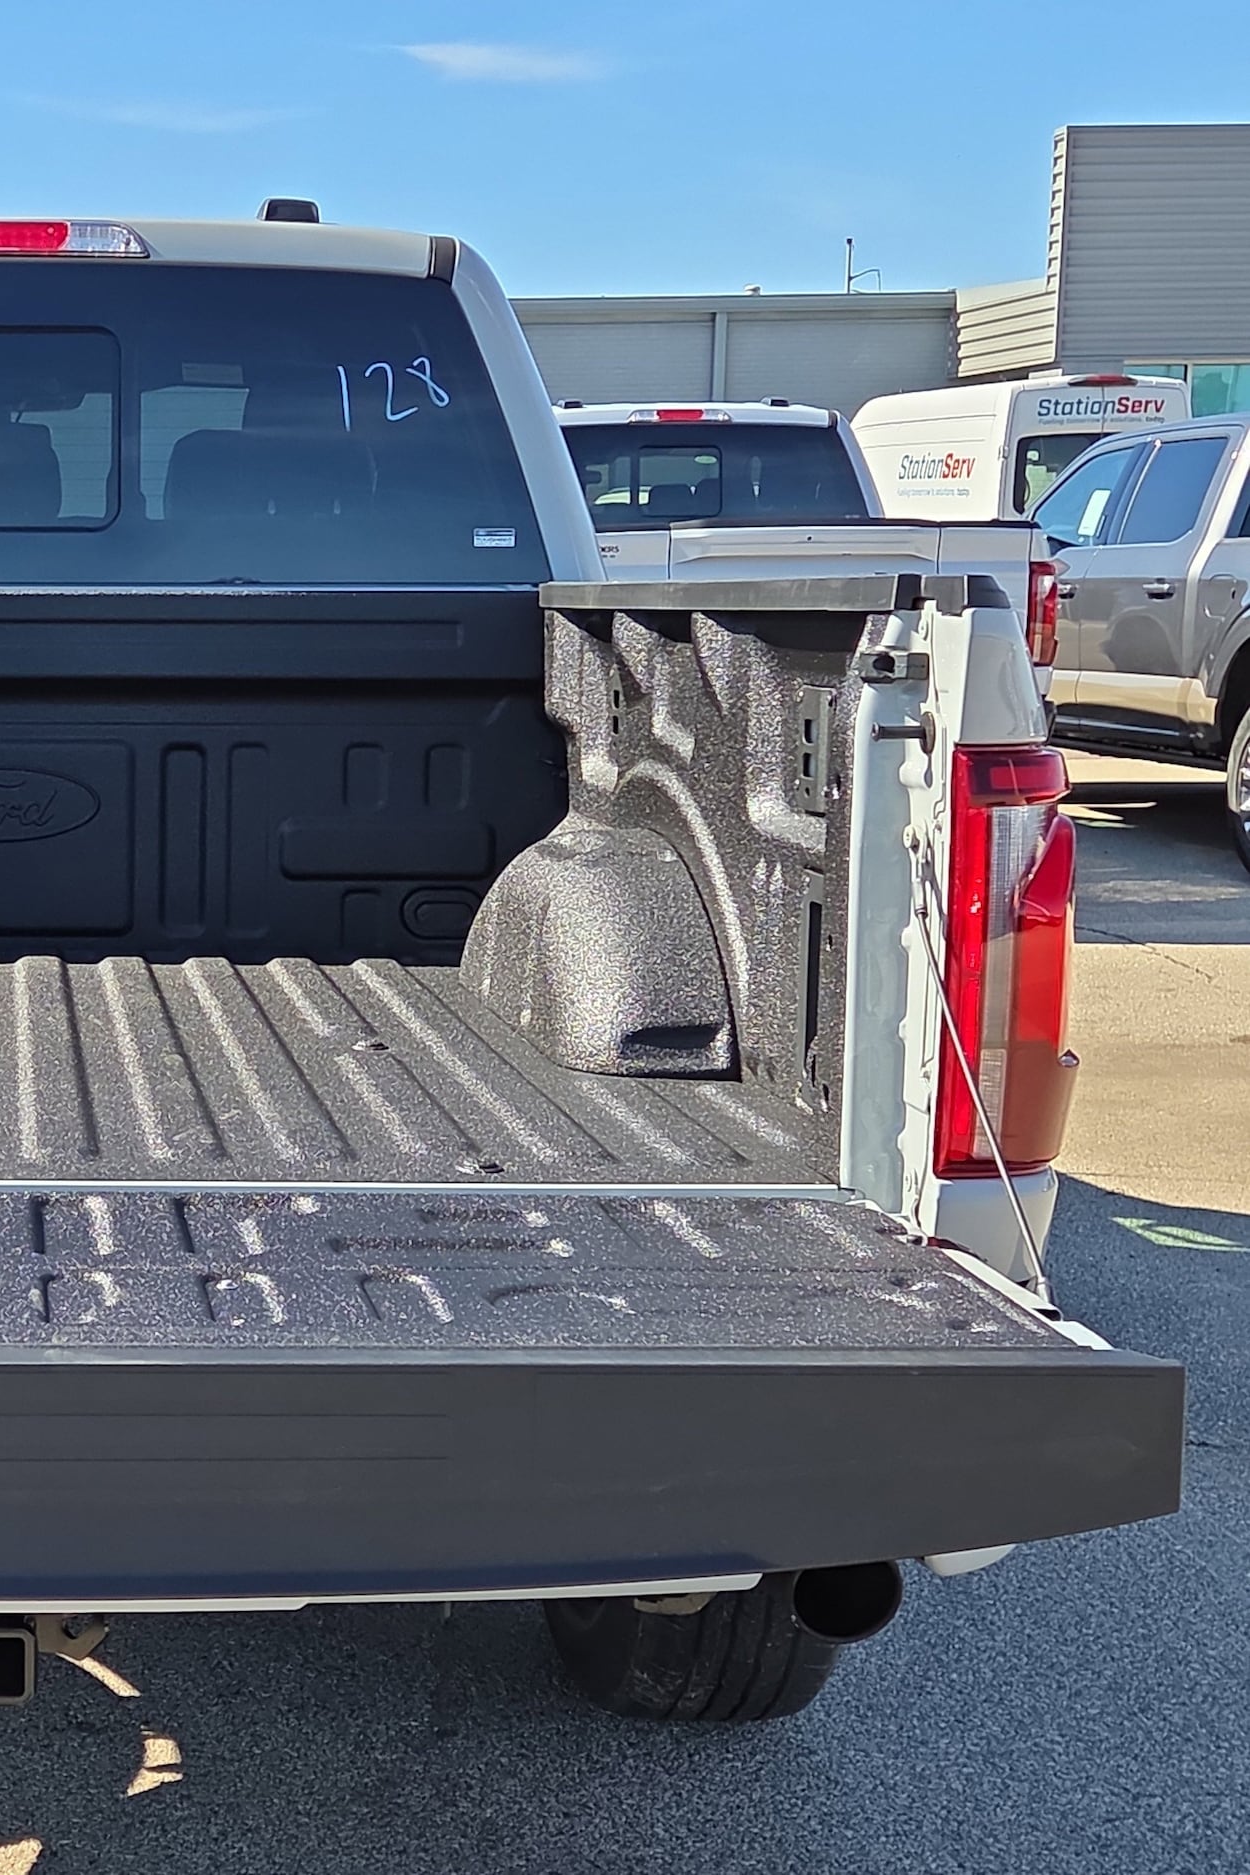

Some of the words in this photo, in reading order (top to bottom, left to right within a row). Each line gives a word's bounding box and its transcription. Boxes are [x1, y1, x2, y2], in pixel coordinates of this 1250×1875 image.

[337, 356, 450, 432] 128
[1037, 396, 1165, 417] StationServ
[899, 452, 976, 480] StationServ
